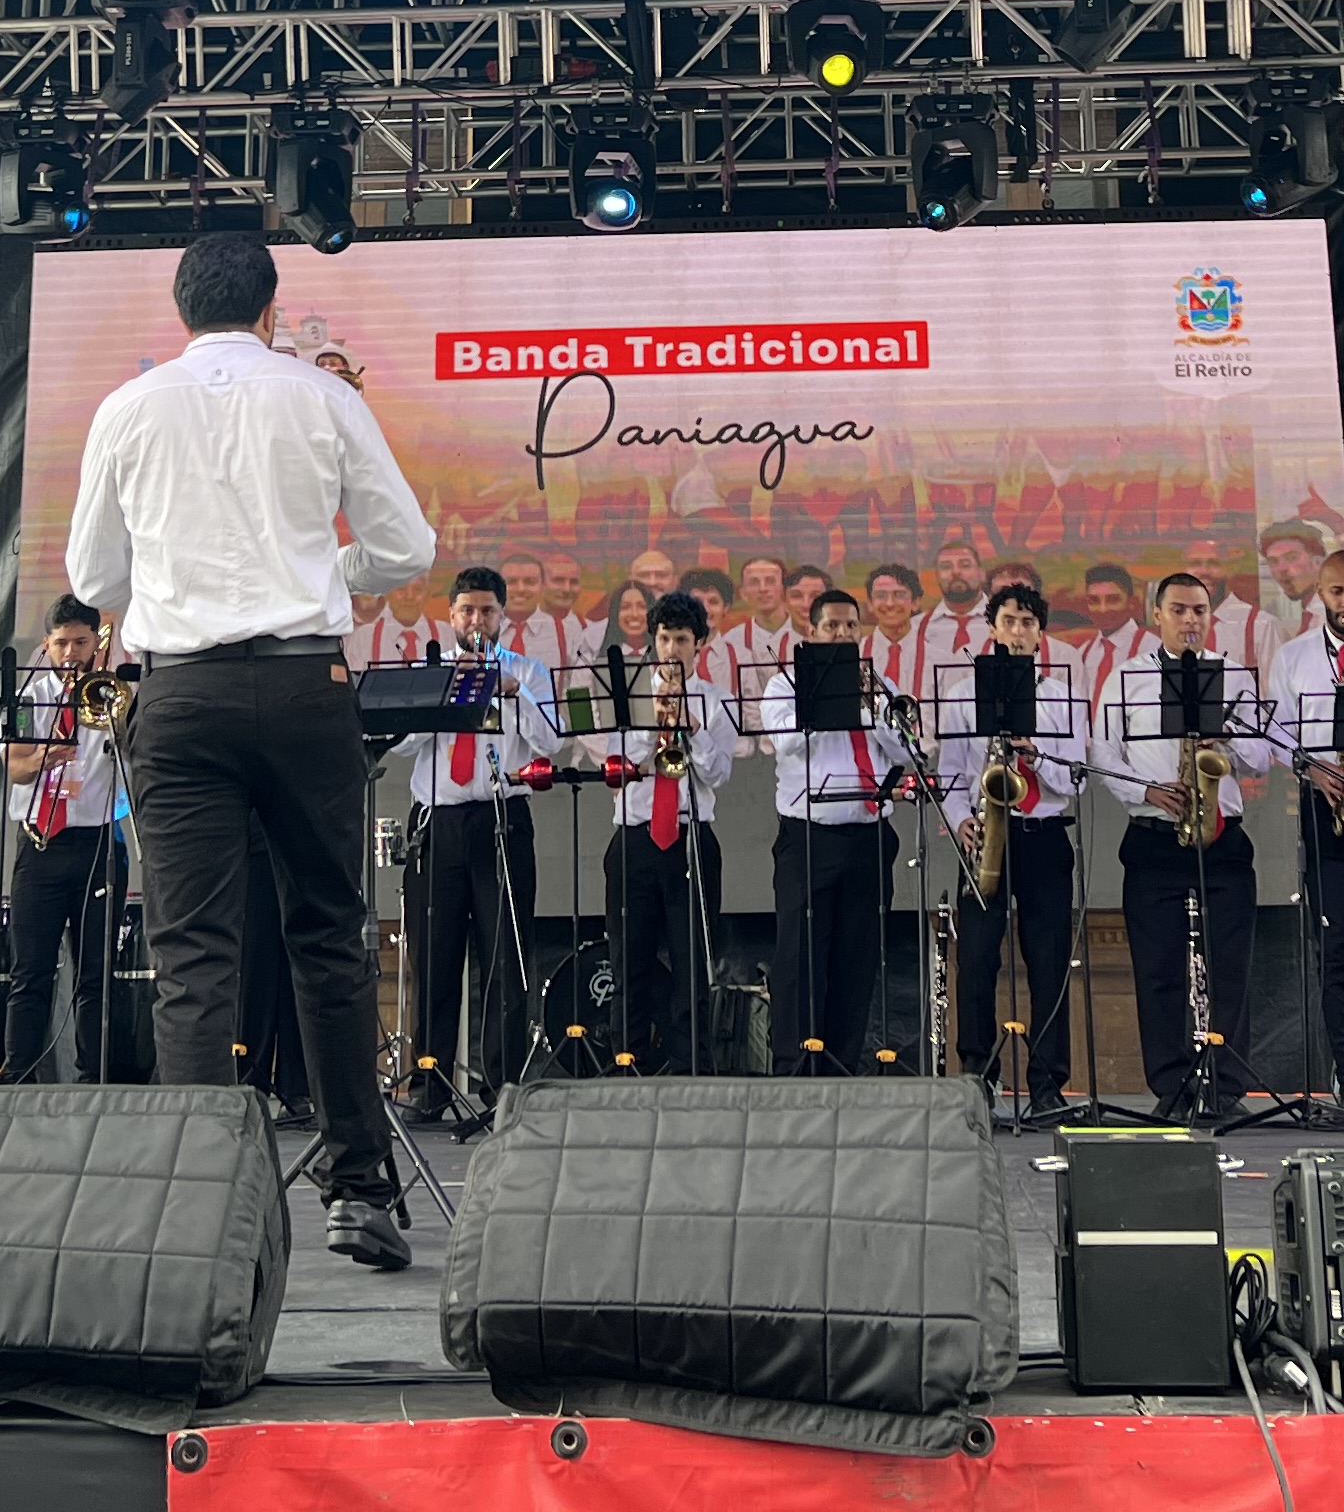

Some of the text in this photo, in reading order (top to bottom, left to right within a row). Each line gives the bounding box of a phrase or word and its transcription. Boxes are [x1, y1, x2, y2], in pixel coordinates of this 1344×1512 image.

[453, 330, 919, 373] Banda Tradicional
[1174, 351, 1252, 362] ALCALDÍA DE
[1175, 362, 1253, 377] El Retiro
[525, 371, 874, 490] Paniagua
